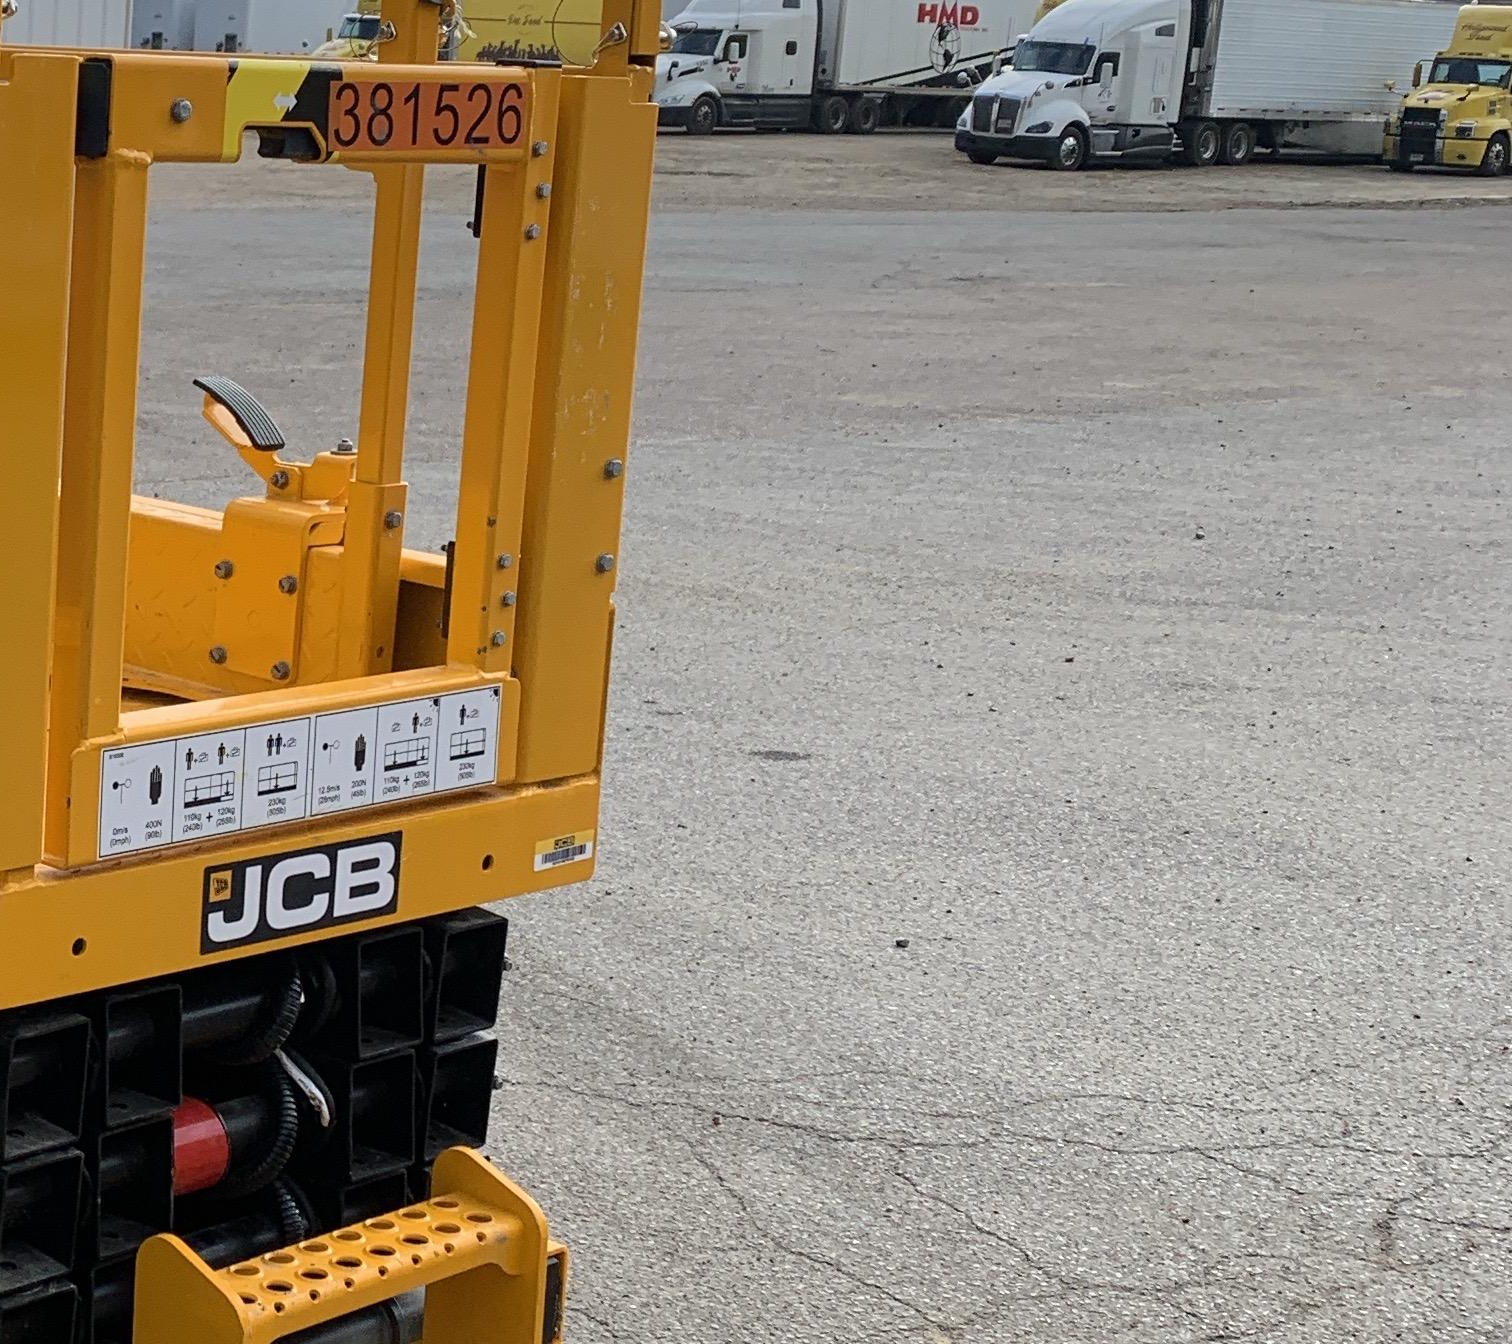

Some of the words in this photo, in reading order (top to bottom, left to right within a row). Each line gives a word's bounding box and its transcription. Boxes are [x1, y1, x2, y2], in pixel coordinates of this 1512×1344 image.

[917, 0, 980, 29] HMD
[333, 82, 524, 148] 381526
[208, 841, 396, 944] JCB
